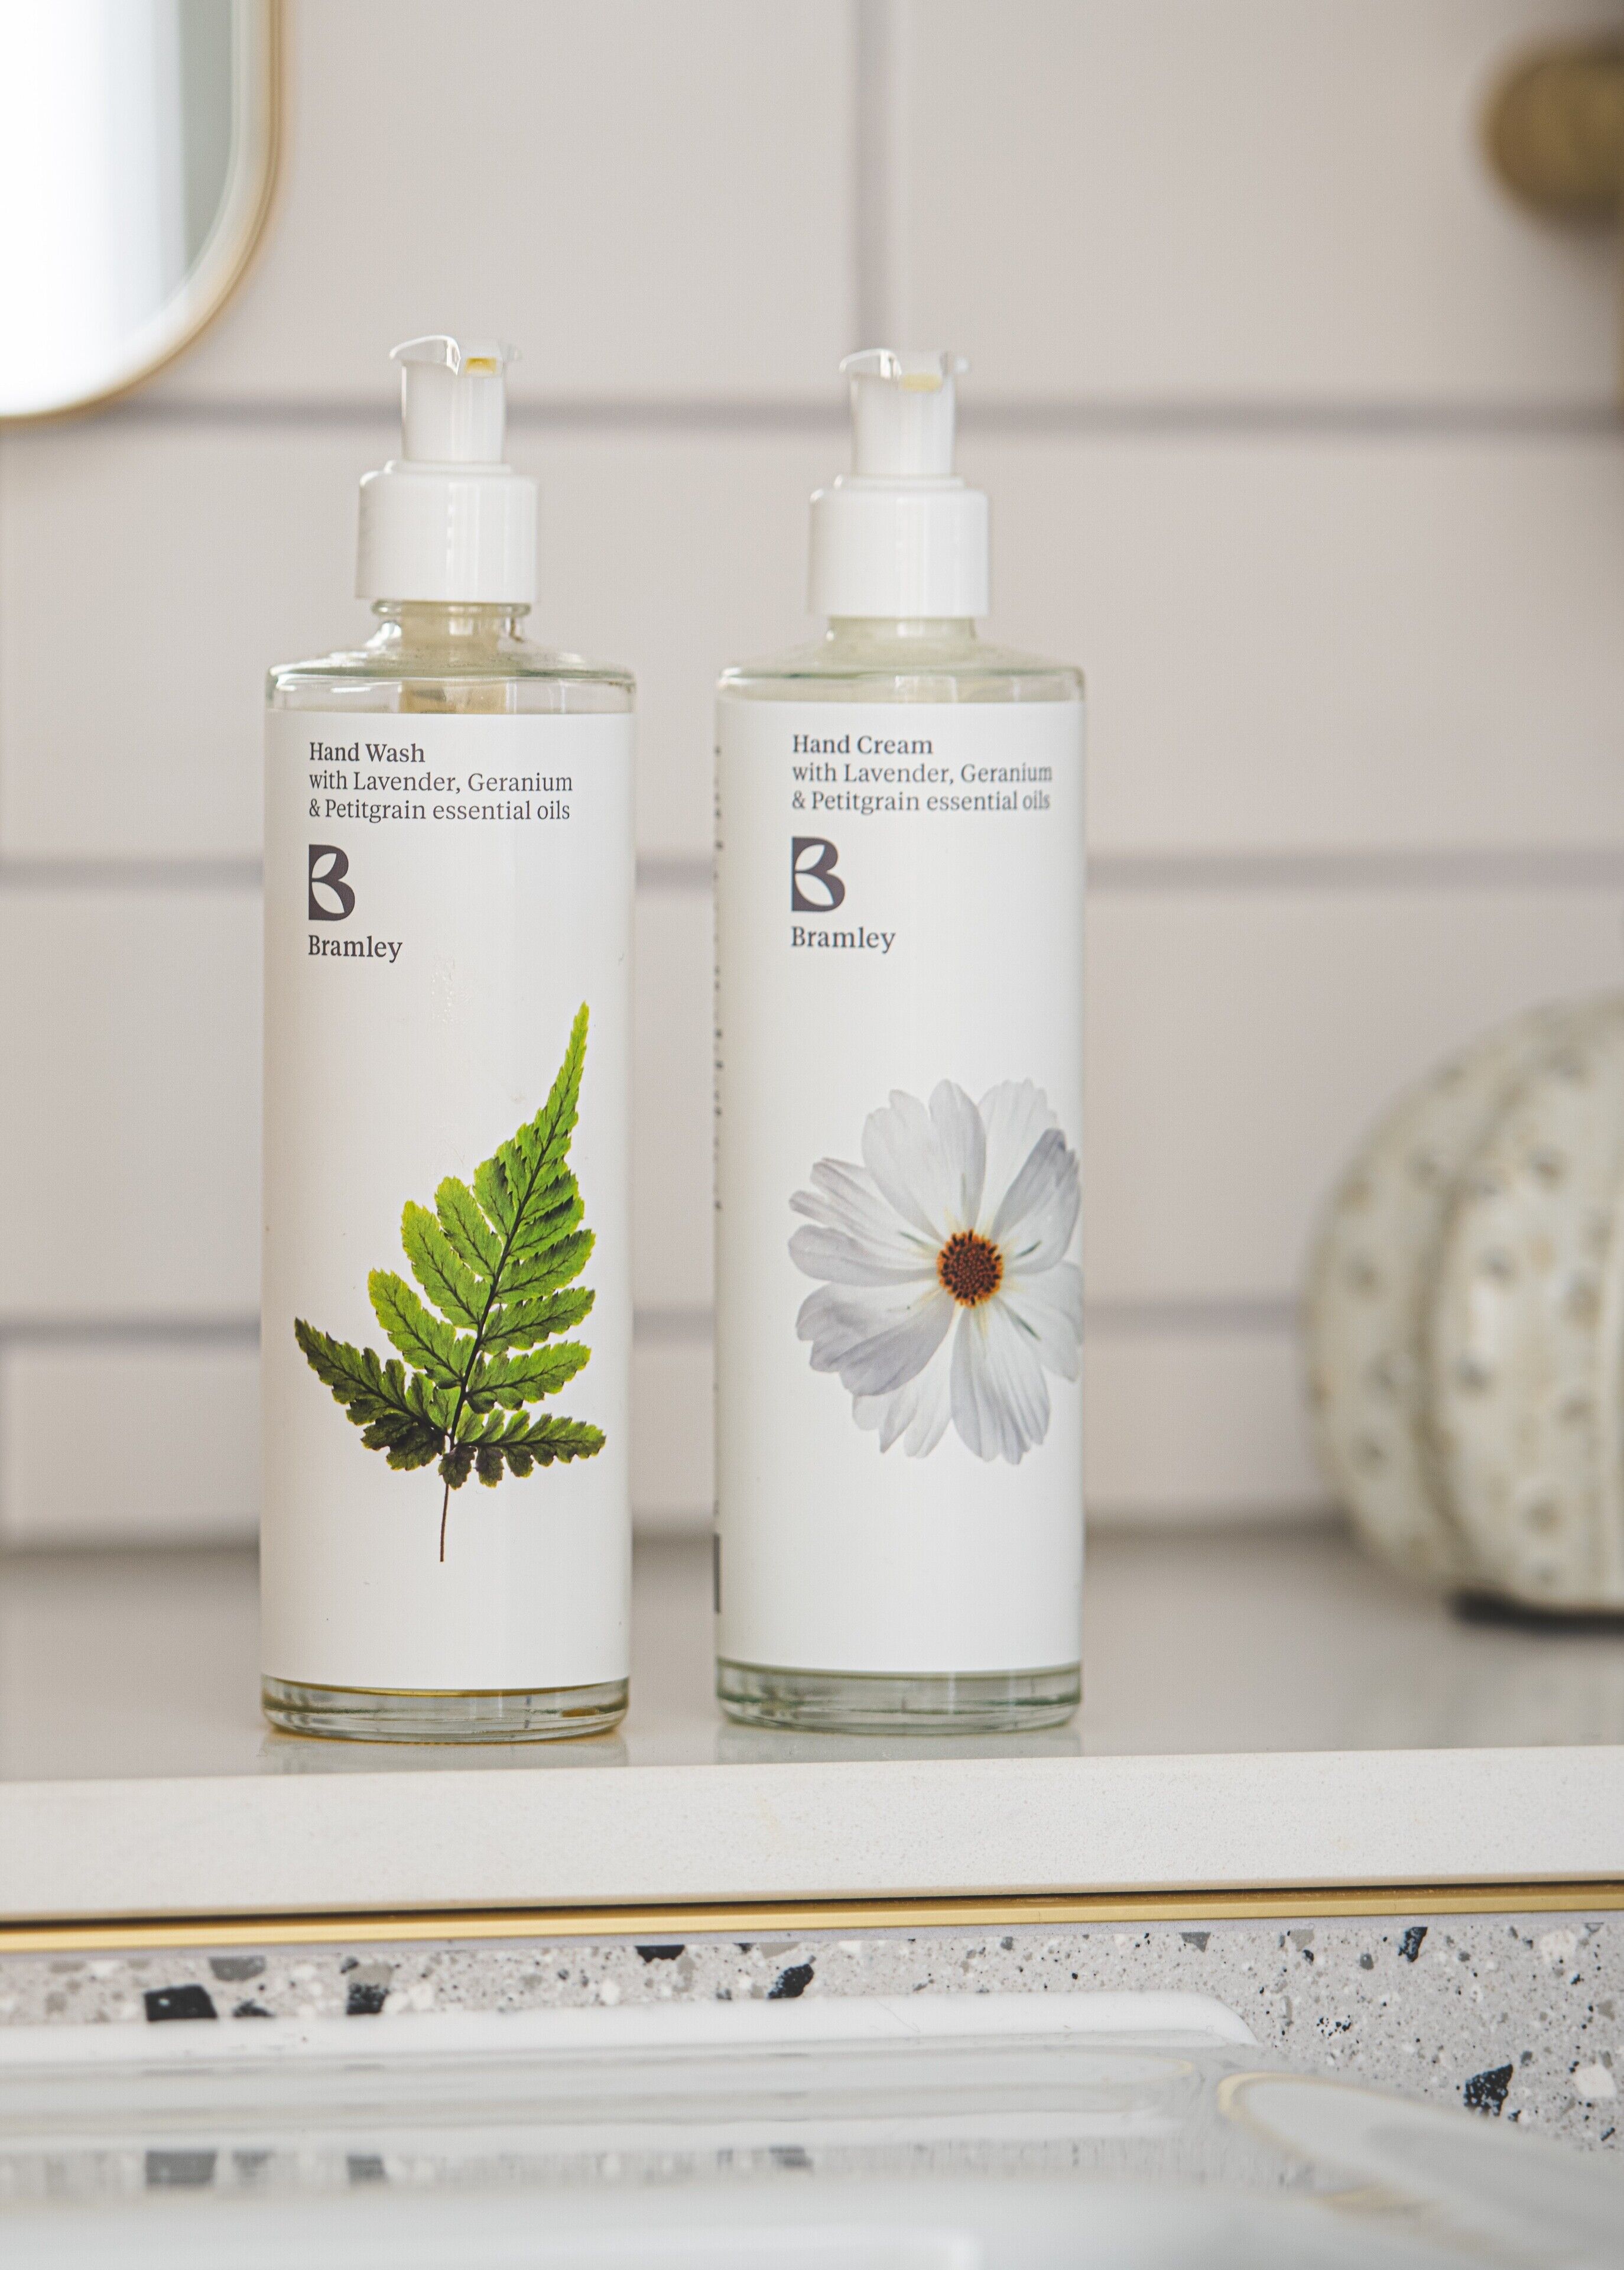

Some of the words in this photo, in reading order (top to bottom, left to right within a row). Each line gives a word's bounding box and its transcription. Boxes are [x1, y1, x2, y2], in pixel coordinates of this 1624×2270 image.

[309, 741, 360, 762] Hand
[365, 742, 426, 763] Wash
[792, 734, 850, 754] Hand
[856, 735, 933, 754] Cream
[308, 769, 348, 790] with
[353, 771, 460, 794] Lavender,
[467, 772, 573, 792] Geranium
[792, 761, 837, 782] with
[844, 763, 954, 785] Lavender,
[960, 763, 1053, 783] Geranium
[308, 798, 321, 818] &
[325, 799, 426, 823] Petitgrain
[433, 800, 531, 820] essential
[537, 800, 570, 820] oils
[792, 790, 805, 809] &
[811, 790, 920, 815] Petitgrain
[927, 790, 1018, 811] essential
[1022, 789, 1051, 811] oils
[308, 844, 356, 922] B
[791, 835, 846, 913] B
[308, 934, 403, 964] Bramley
[791, 926, 896, 954] Bramley
